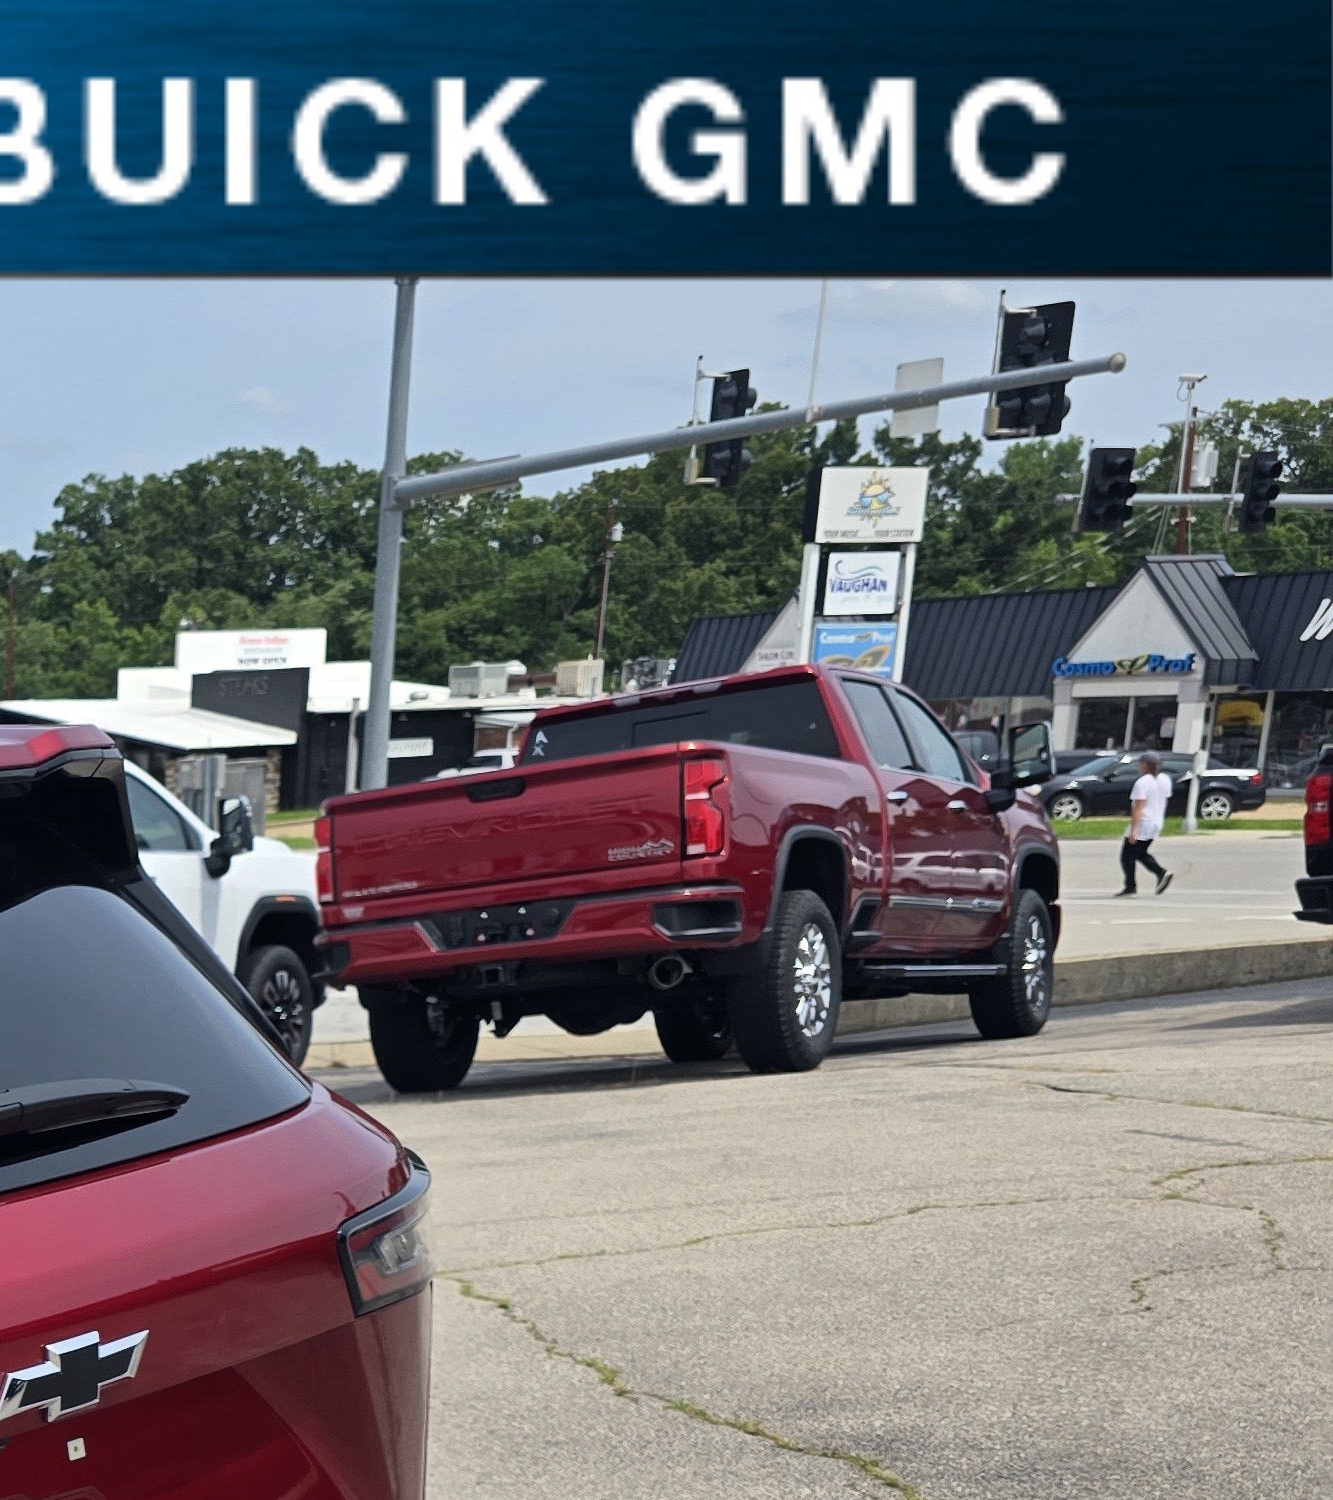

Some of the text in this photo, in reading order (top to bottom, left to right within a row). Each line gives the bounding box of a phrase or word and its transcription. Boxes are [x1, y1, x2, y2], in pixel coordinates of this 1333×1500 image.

[830, 577, 889, 593] VAUGHAN
[1052, 652, 1196, 677] Cosmo Prof
